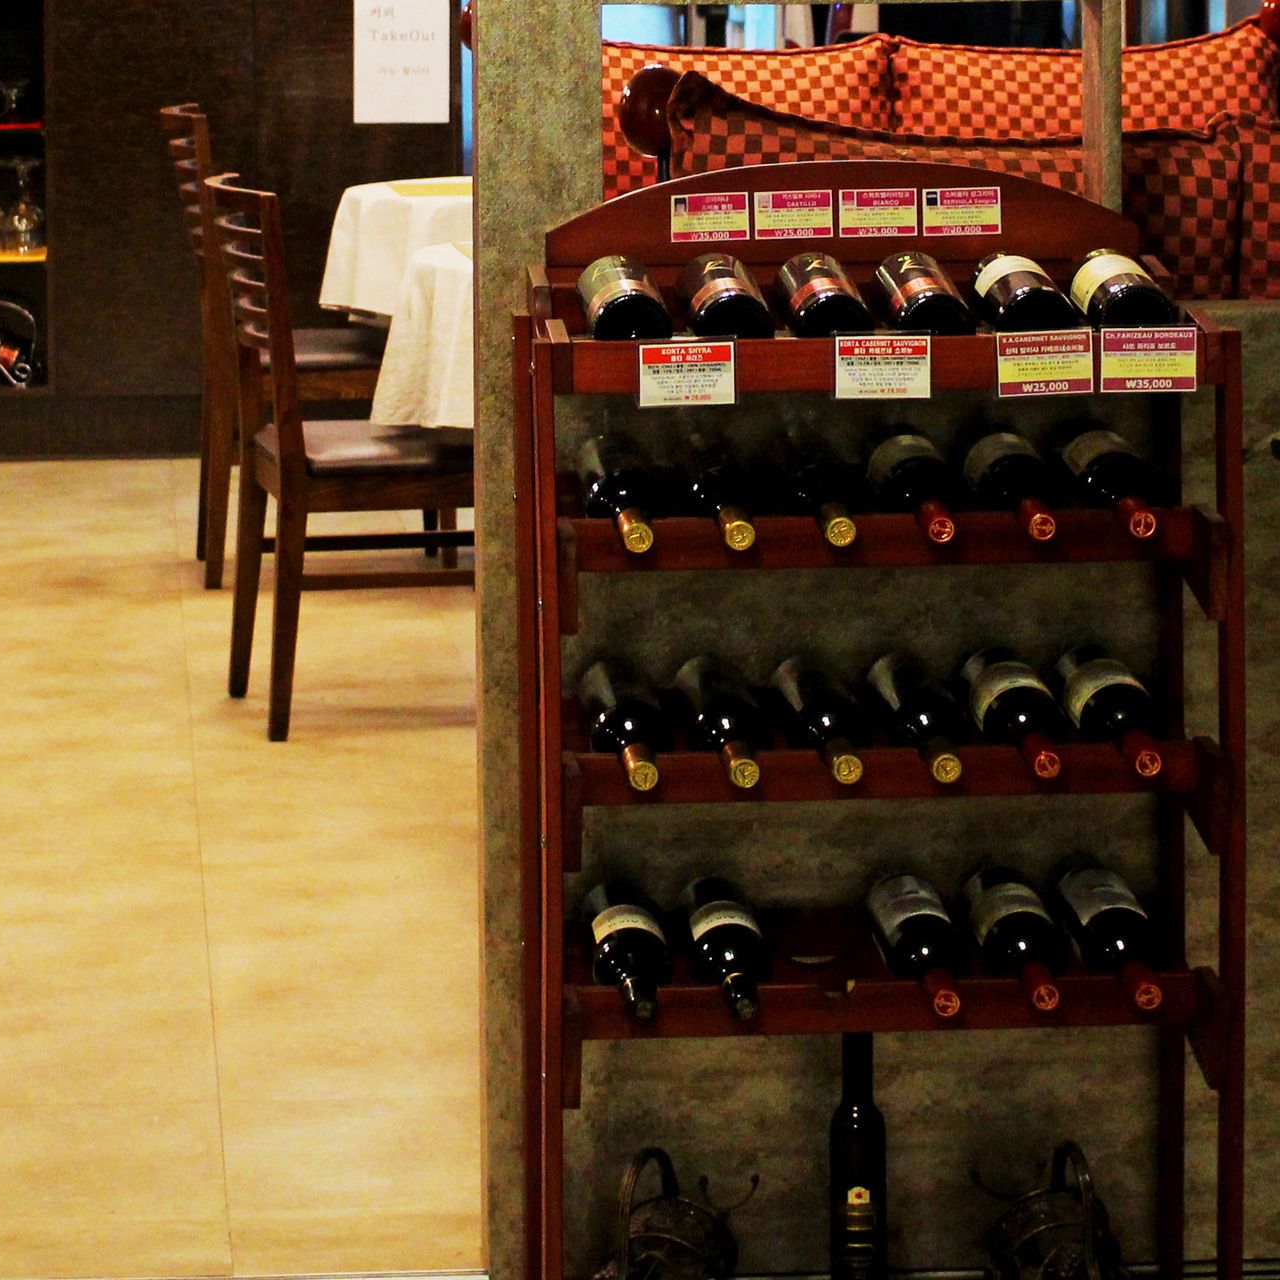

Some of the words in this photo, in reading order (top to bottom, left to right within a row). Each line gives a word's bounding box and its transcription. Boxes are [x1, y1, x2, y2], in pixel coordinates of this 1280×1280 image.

[369, 29, 437, 42] TakeOut
[1049, 333, 1087, 341] SAUVIGNON
[1154, 331, 1194, 339] BORDEAUX
[661, 347, 686, 355] KORTA
[688, 346, 712, 354] SHYRA
[1022, 381, 1069, 393] ₩25,000
[1125, 379, 1173, 389] ₩35,000
